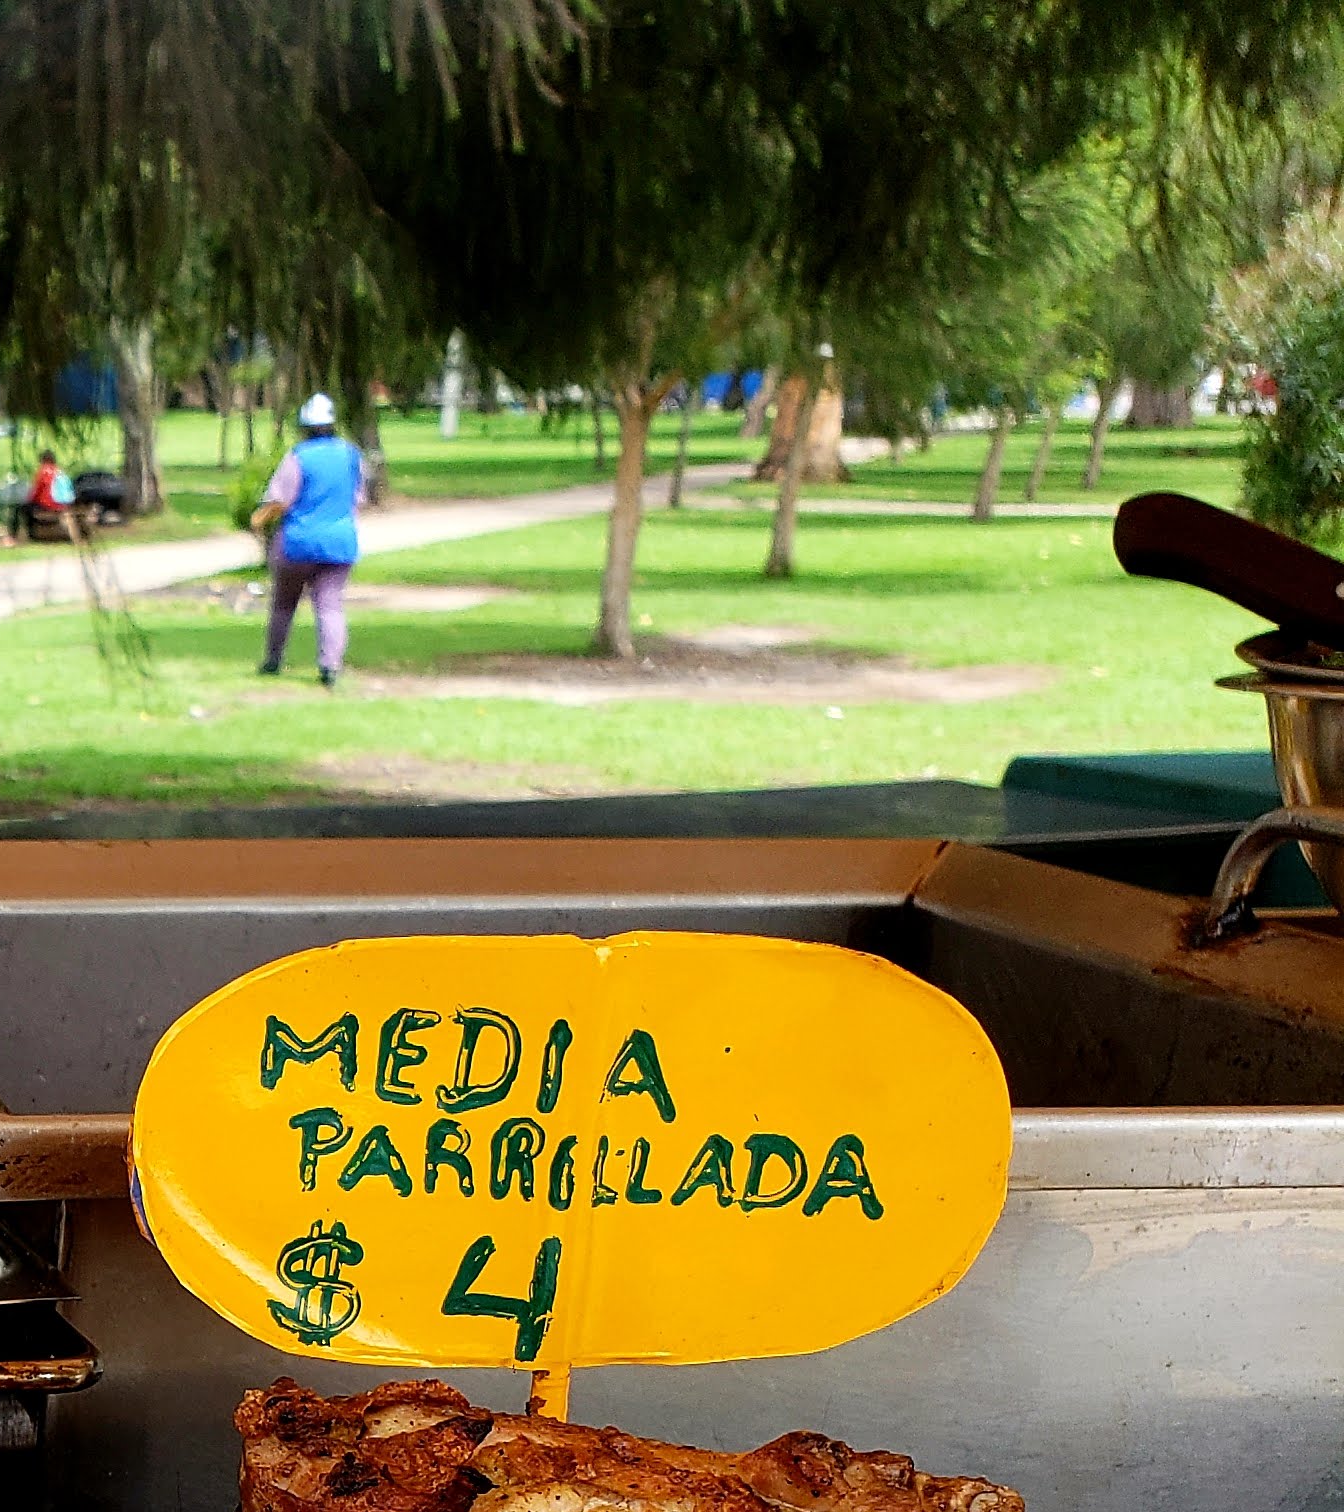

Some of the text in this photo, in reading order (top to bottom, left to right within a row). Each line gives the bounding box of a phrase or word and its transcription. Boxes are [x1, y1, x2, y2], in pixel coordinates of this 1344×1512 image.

[261, 1007, 676, 1122] MEDIA
[289, 1107, 884, 1220] PARRILLADA
[441, 1236, 562, 1362] 4
